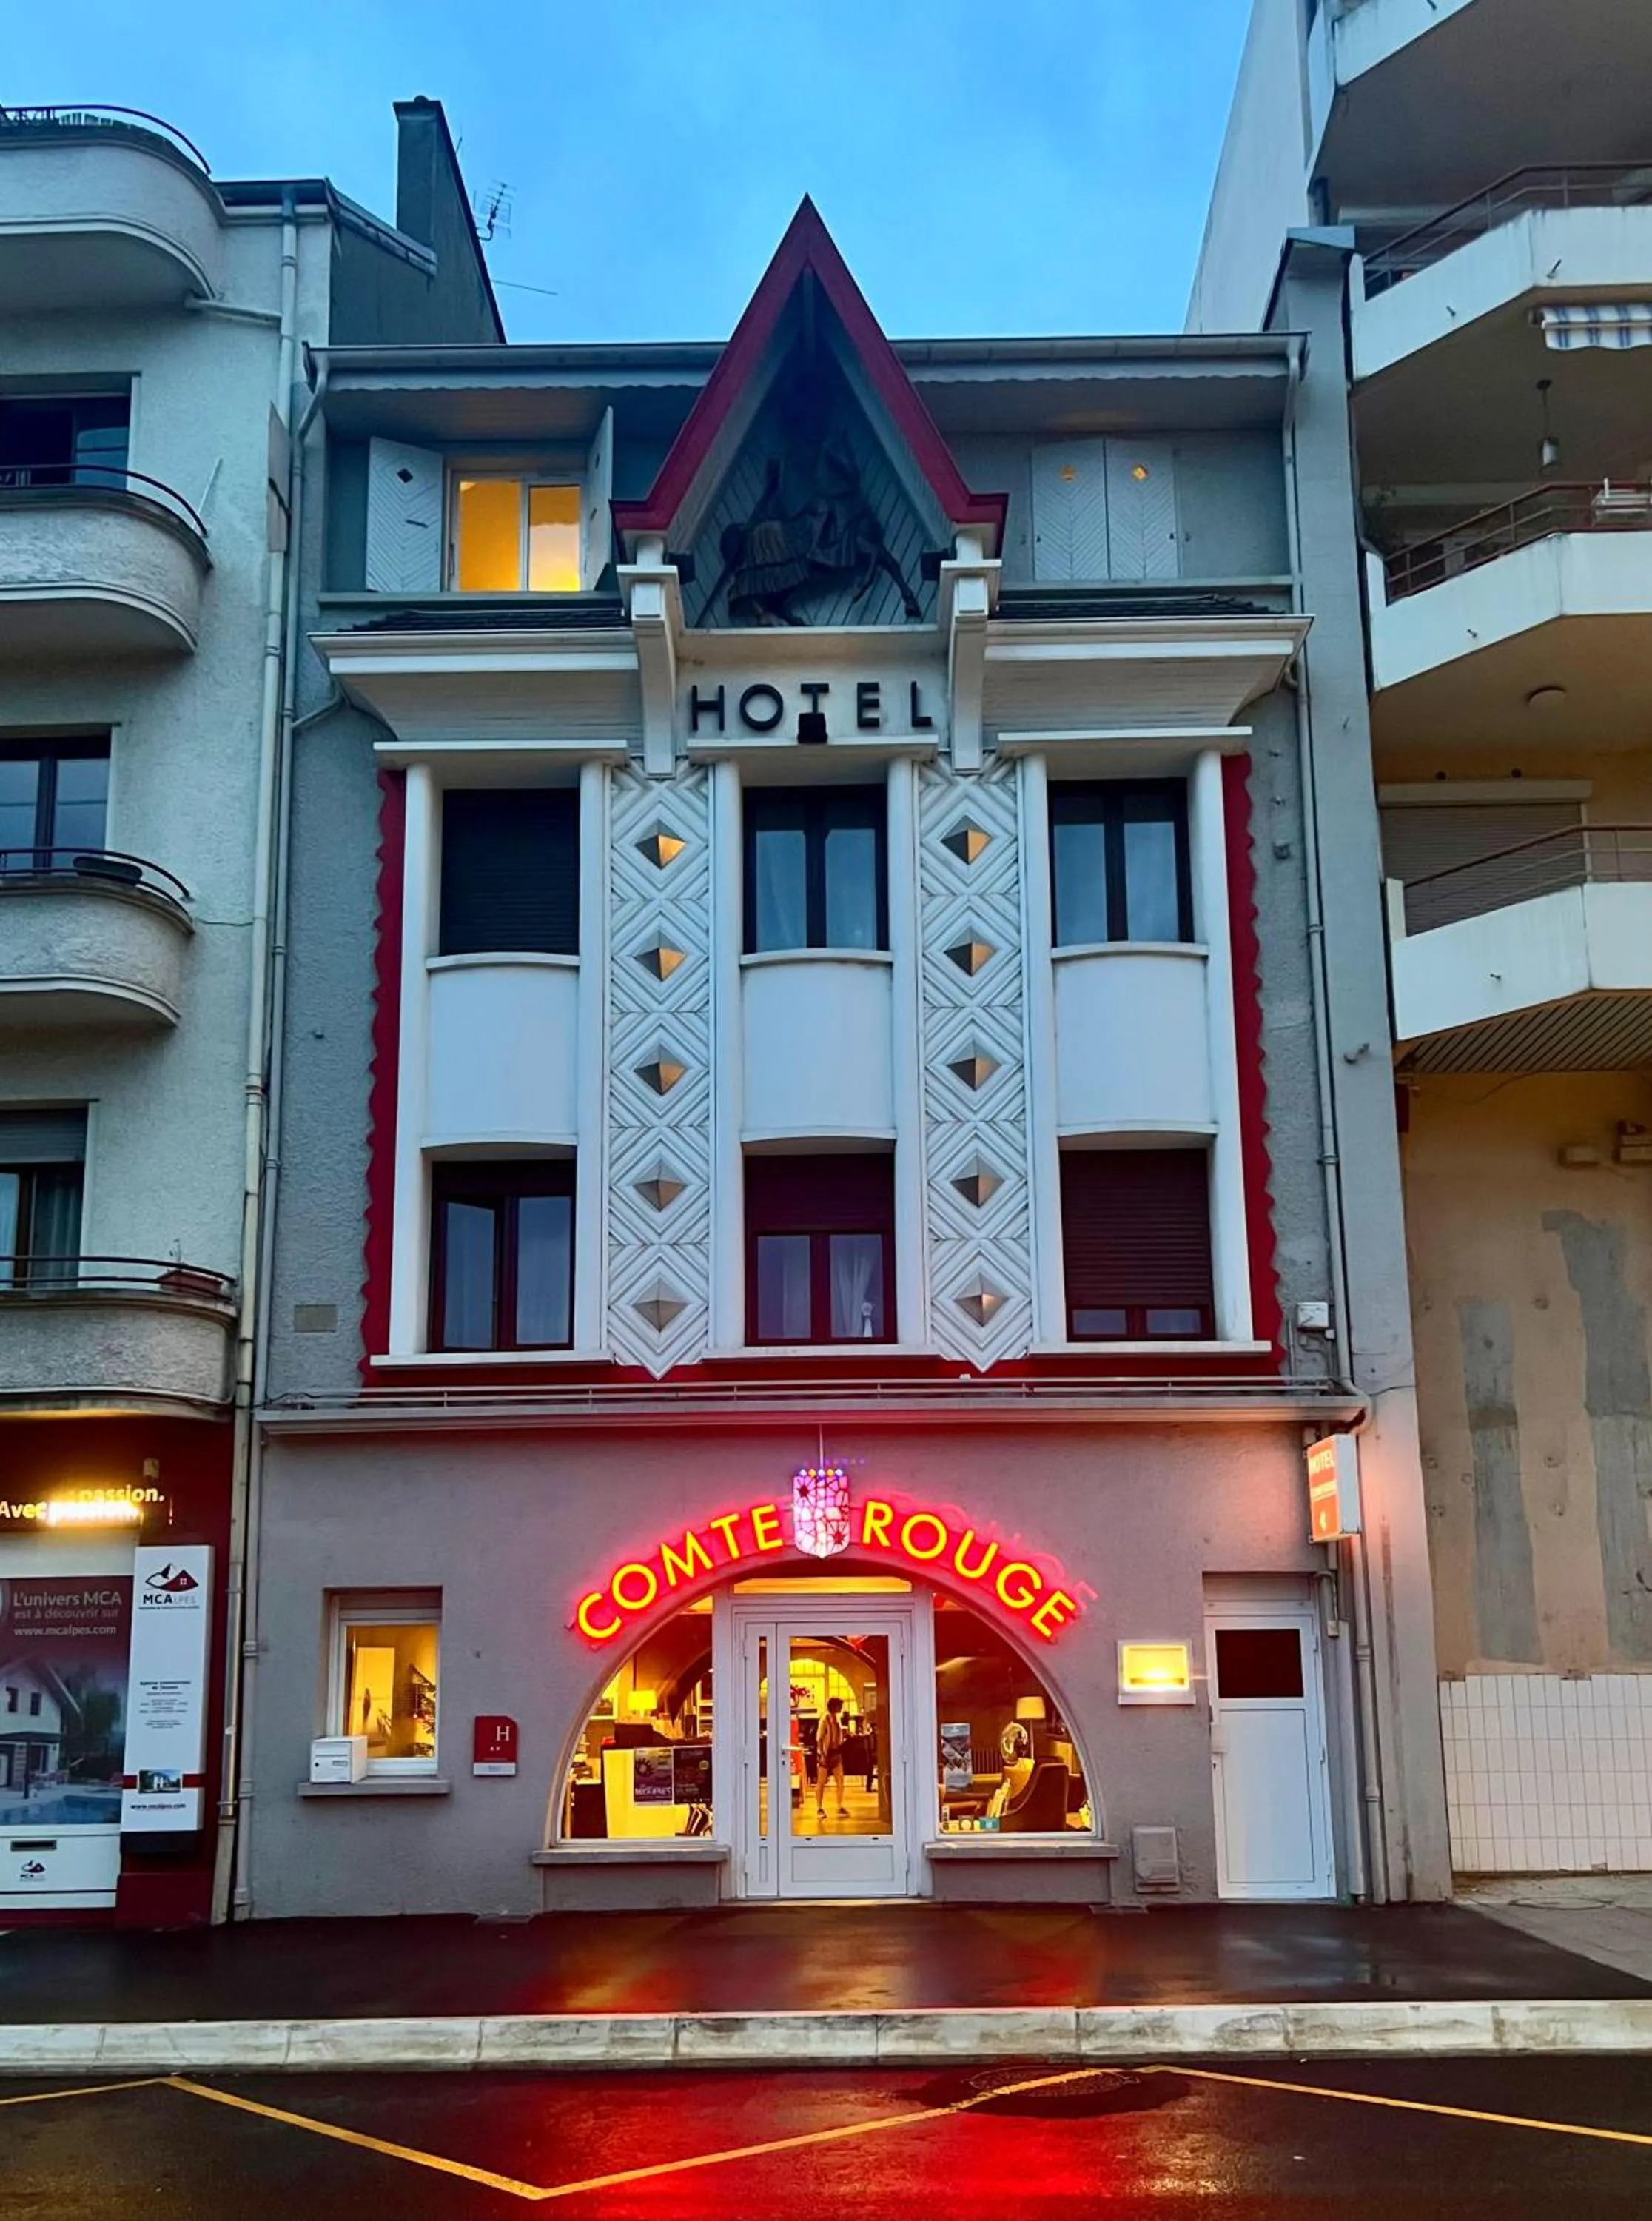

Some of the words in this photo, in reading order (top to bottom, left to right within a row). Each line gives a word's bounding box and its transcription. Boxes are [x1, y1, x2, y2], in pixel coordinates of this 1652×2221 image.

[691, 681, 932, 731] HOTEL
[577, 1504, 782, 1639] COMTE
[862, 1500, 1076, 1637] ROUGE
[14, 1592, 80, 1606] L'univers
[84, 1591, 121, 1605] MCA
[13, 1624, 117, 1636] www.mcalpes.com
[497, 1726, 510, 1741] H
